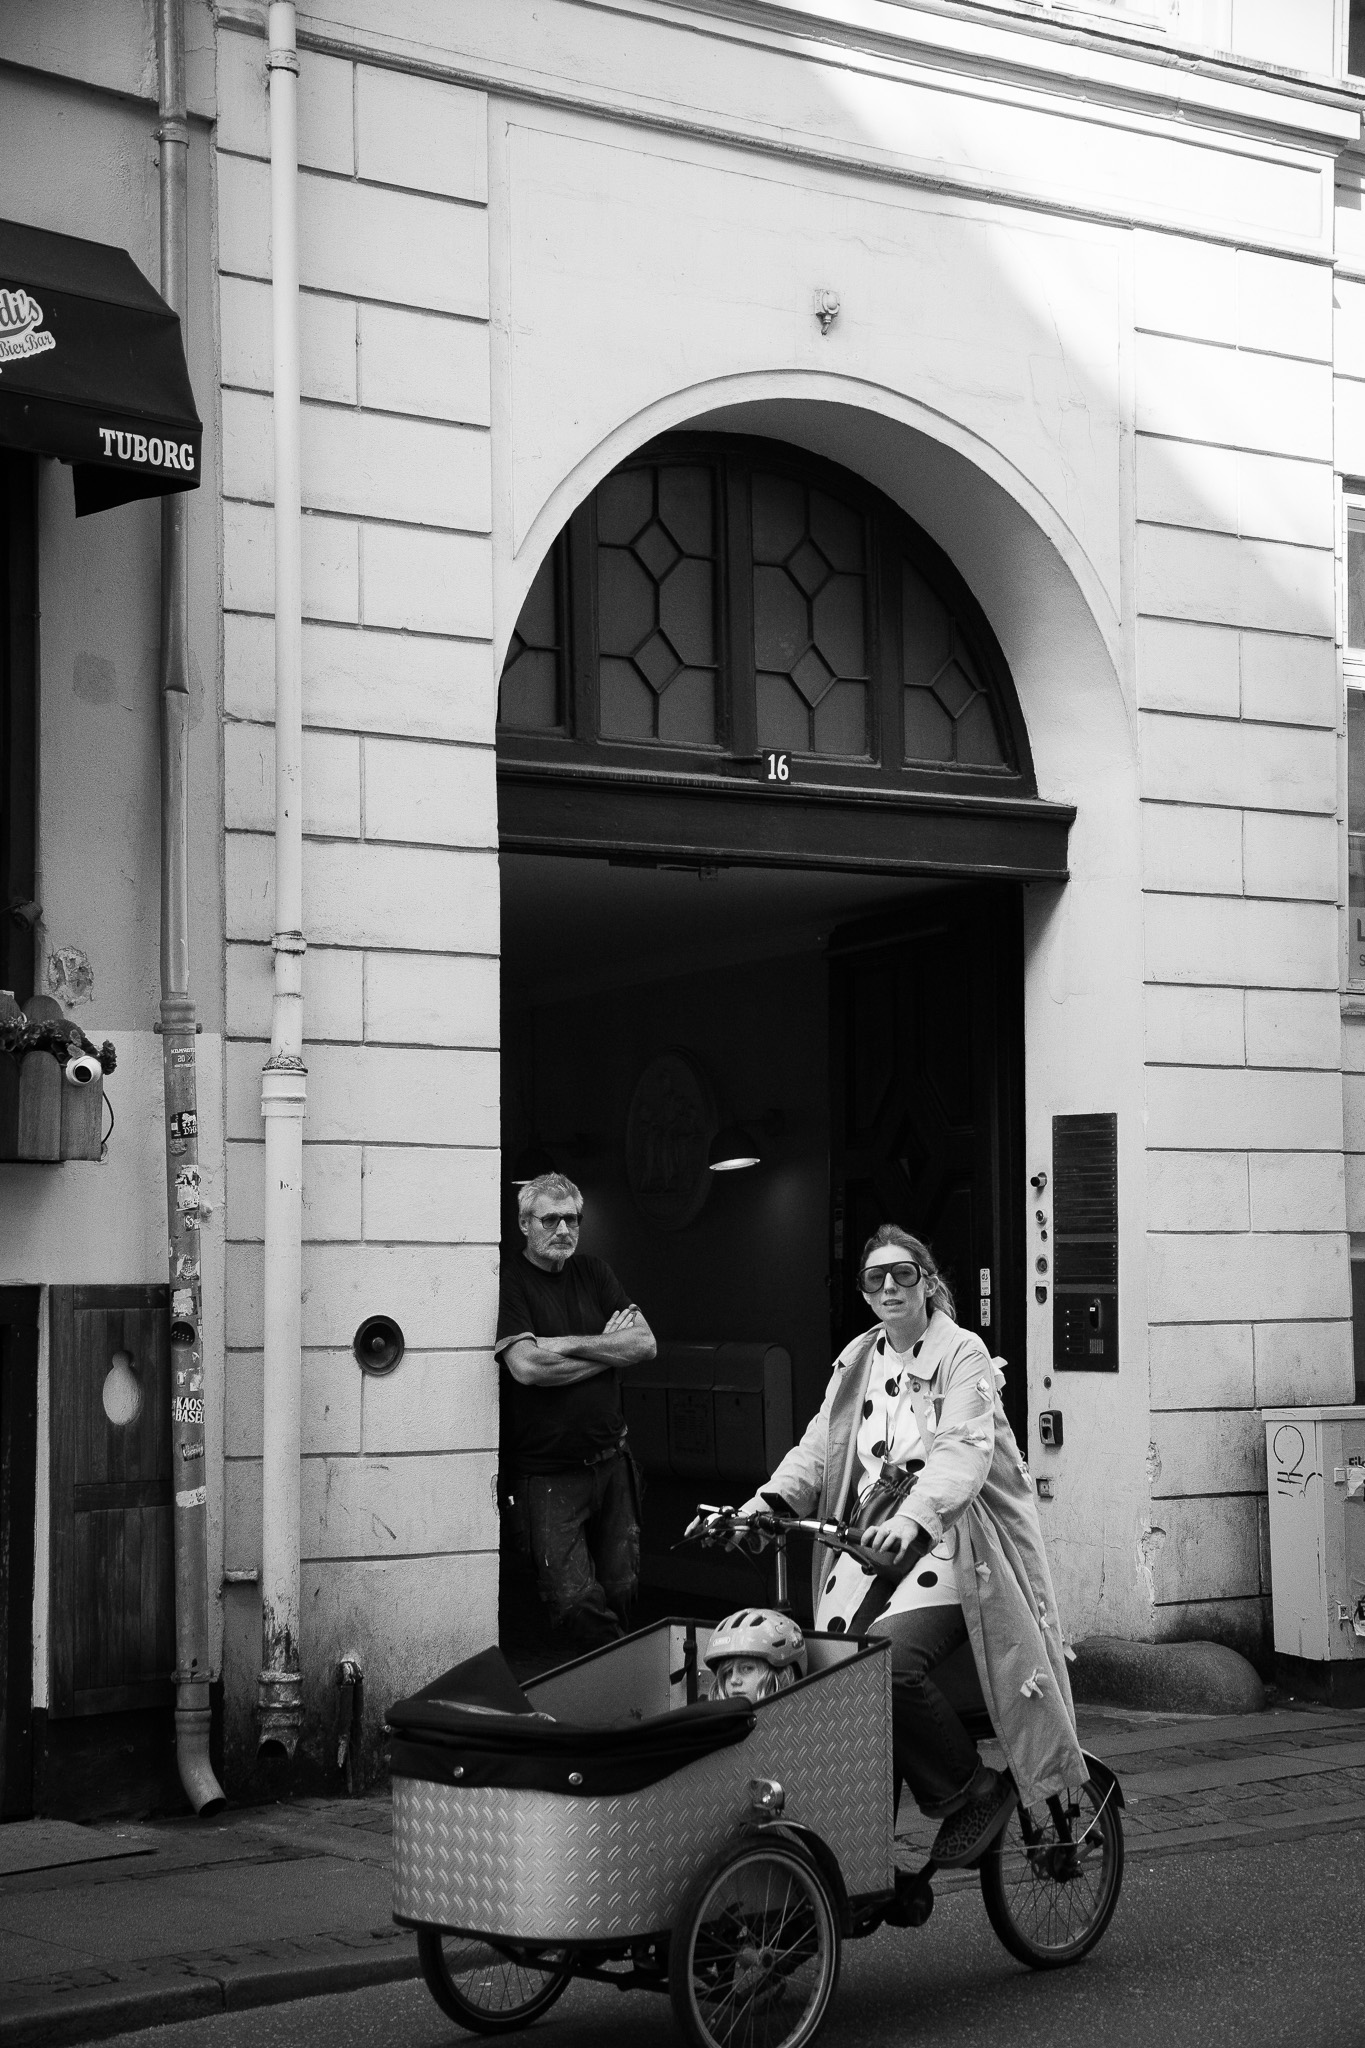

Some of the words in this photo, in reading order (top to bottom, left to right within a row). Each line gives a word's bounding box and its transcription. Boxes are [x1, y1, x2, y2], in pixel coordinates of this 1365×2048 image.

[0, 292, 39, 327] di's
[0, 341, 27, 358] Bier
[25, 333, 52, 351] Bar
[99, 427, 195, 471] TUBORG
[767, 753, 789, 781] 16
[175, 1409, 204, 1424] BASEL
